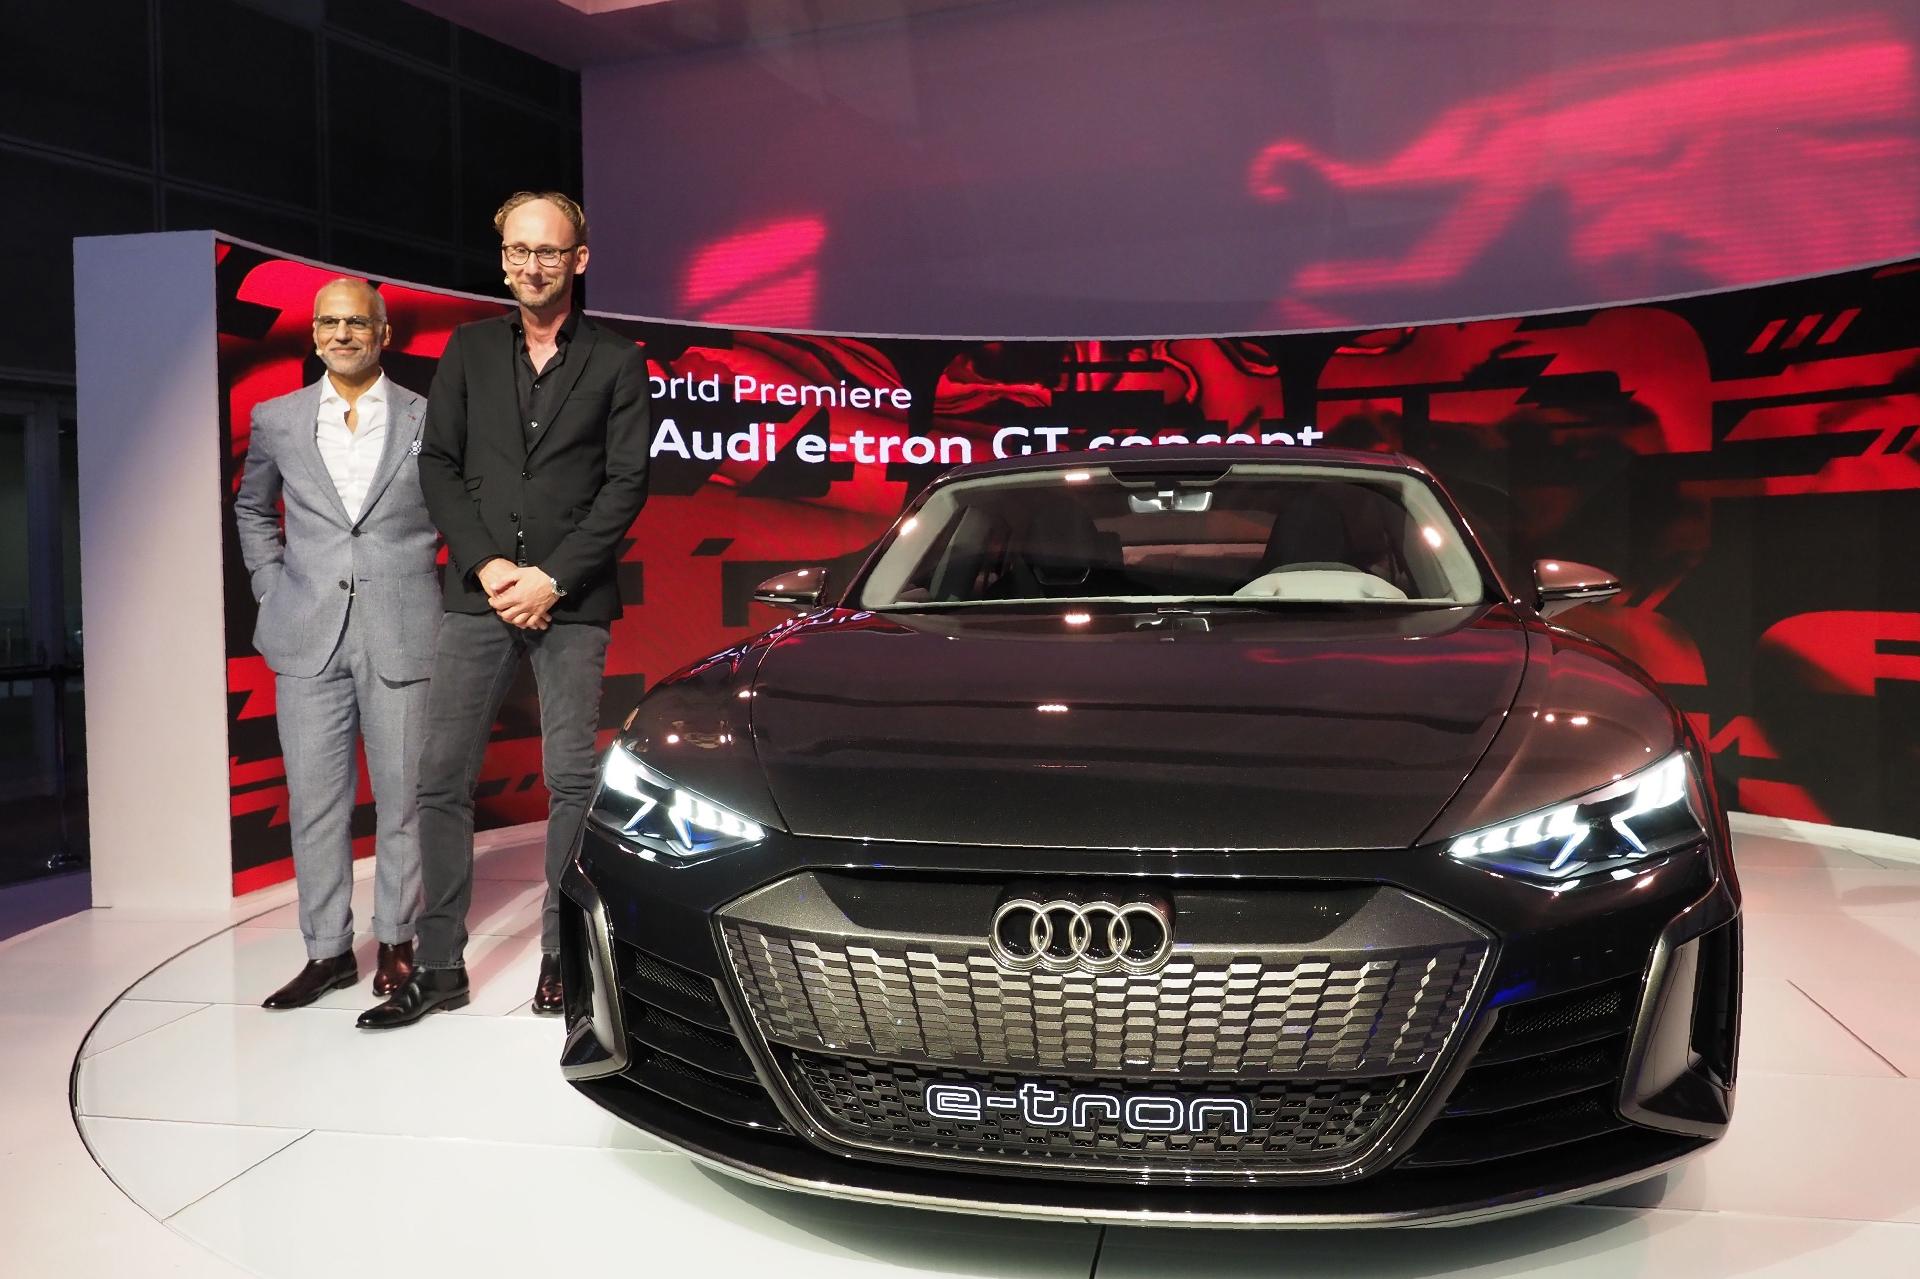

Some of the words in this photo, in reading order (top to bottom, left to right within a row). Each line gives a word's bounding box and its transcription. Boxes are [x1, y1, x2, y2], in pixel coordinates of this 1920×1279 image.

[649, 371, 720, 402] orld
[734, 375, 912, 409] Premiere
[649, 418, 776, 462] Audi
[796, 430, 972, 464] e-tron
[992, 426, 1069, 460] GT
[926, 1083, 1249, 1133] e-tron
